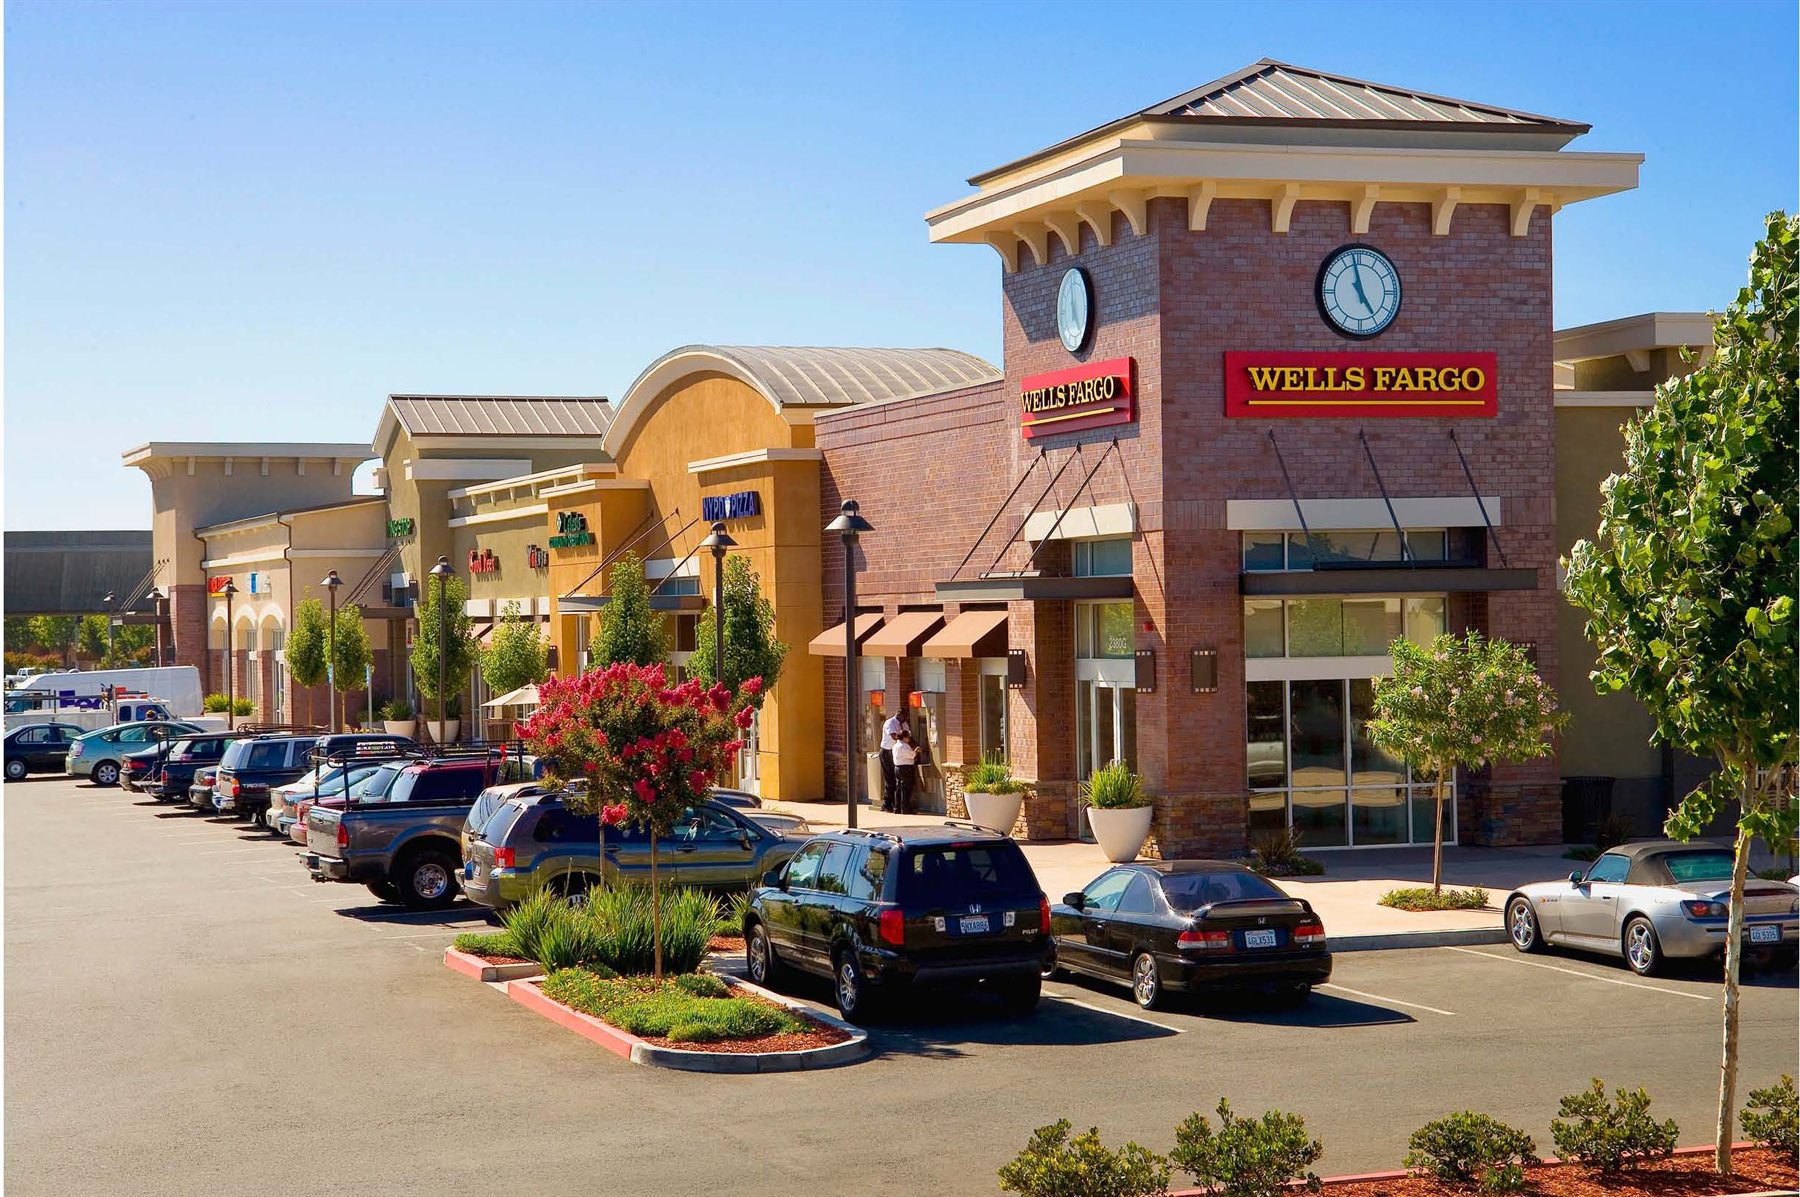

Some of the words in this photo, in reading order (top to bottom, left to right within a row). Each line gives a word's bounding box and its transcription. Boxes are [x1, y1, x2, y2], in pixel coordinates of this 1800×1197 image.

[1248, 367, 1365, 391] WELLS
[1373, 367, 1485, 391] FARGO
[1021, 384, 1065, 413] WELLS
[1068, 376, 1114, 406] FARGO
[731, 491, 755, 518] PIZZA
